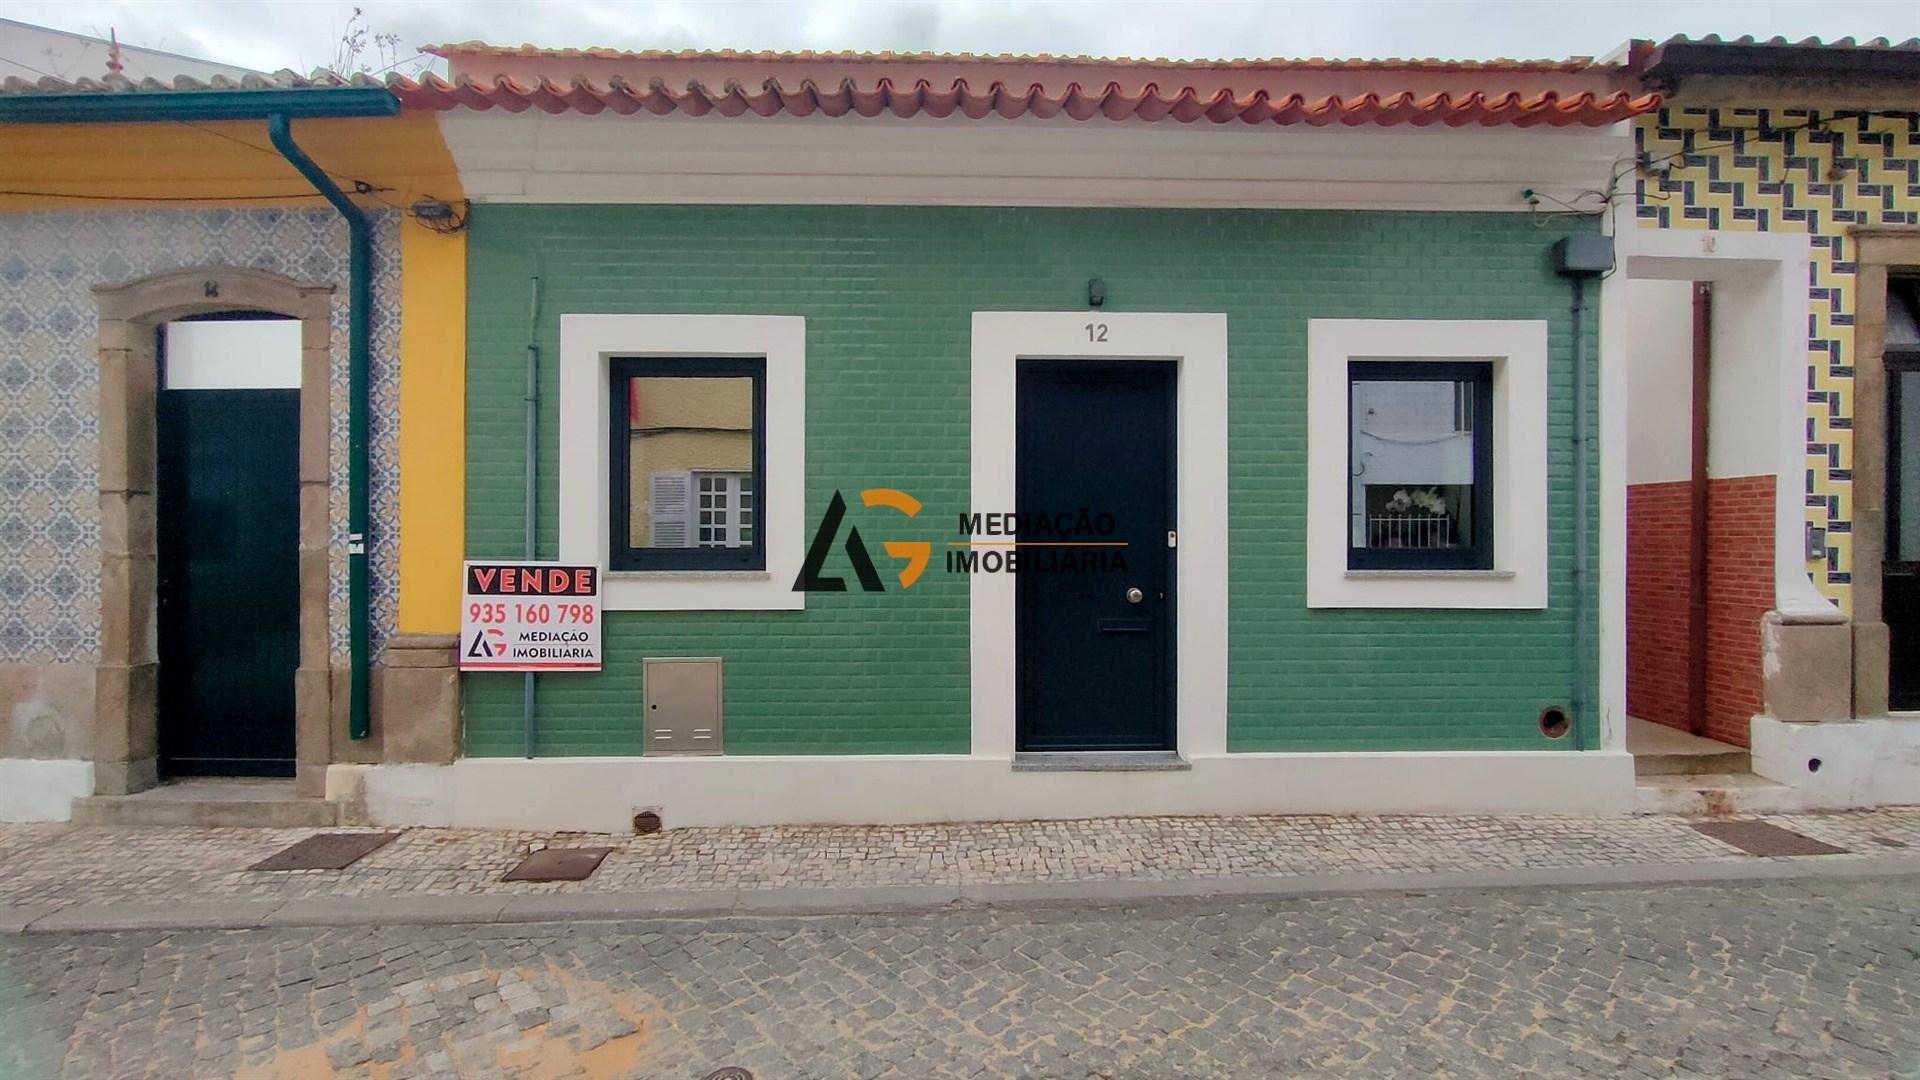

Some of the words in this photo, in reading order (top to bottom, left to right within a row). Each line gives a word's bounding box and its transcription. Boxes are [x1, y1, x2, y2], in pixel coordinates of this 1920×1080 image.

[1085, 323, 1108, 342] 12
[473, 568, 592, 593] VENDE
[470, 603, 506, 623] 935
[515, 604, 550, 624] 160
[557, 604, 594, 624] 798
[519, 629, 589, 645] MEDIAÇÃO
